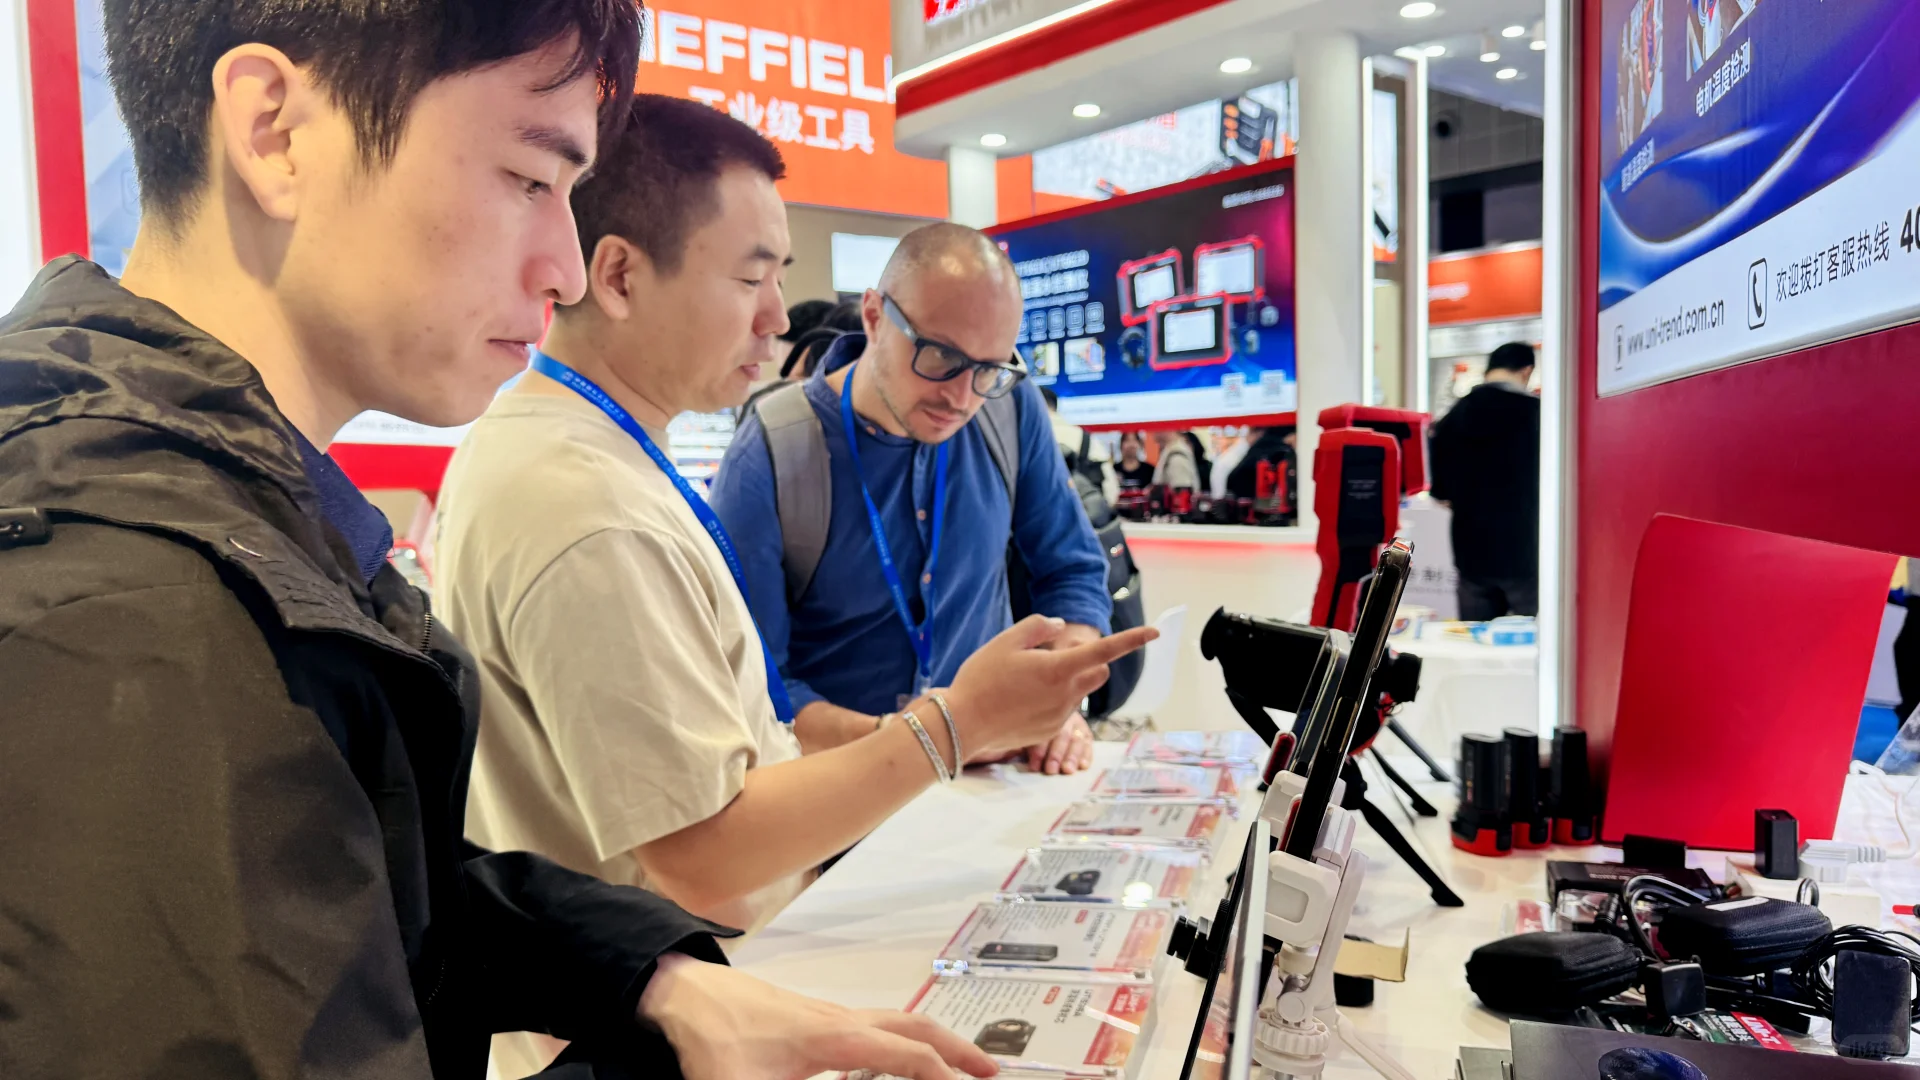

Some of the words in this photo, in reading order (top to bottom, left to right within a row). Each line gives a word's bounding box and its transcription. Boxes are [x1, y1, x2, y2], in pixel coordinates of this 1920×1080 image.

[641, 8, 895, 104] EFFIEL
[1696, 36, 1751, 117] 电机温度检测
[1776, 221, 1890, 302] 欢迎拨打客服热线
[1627, 299, 1725, 356] www.uni-trend.com.cn
